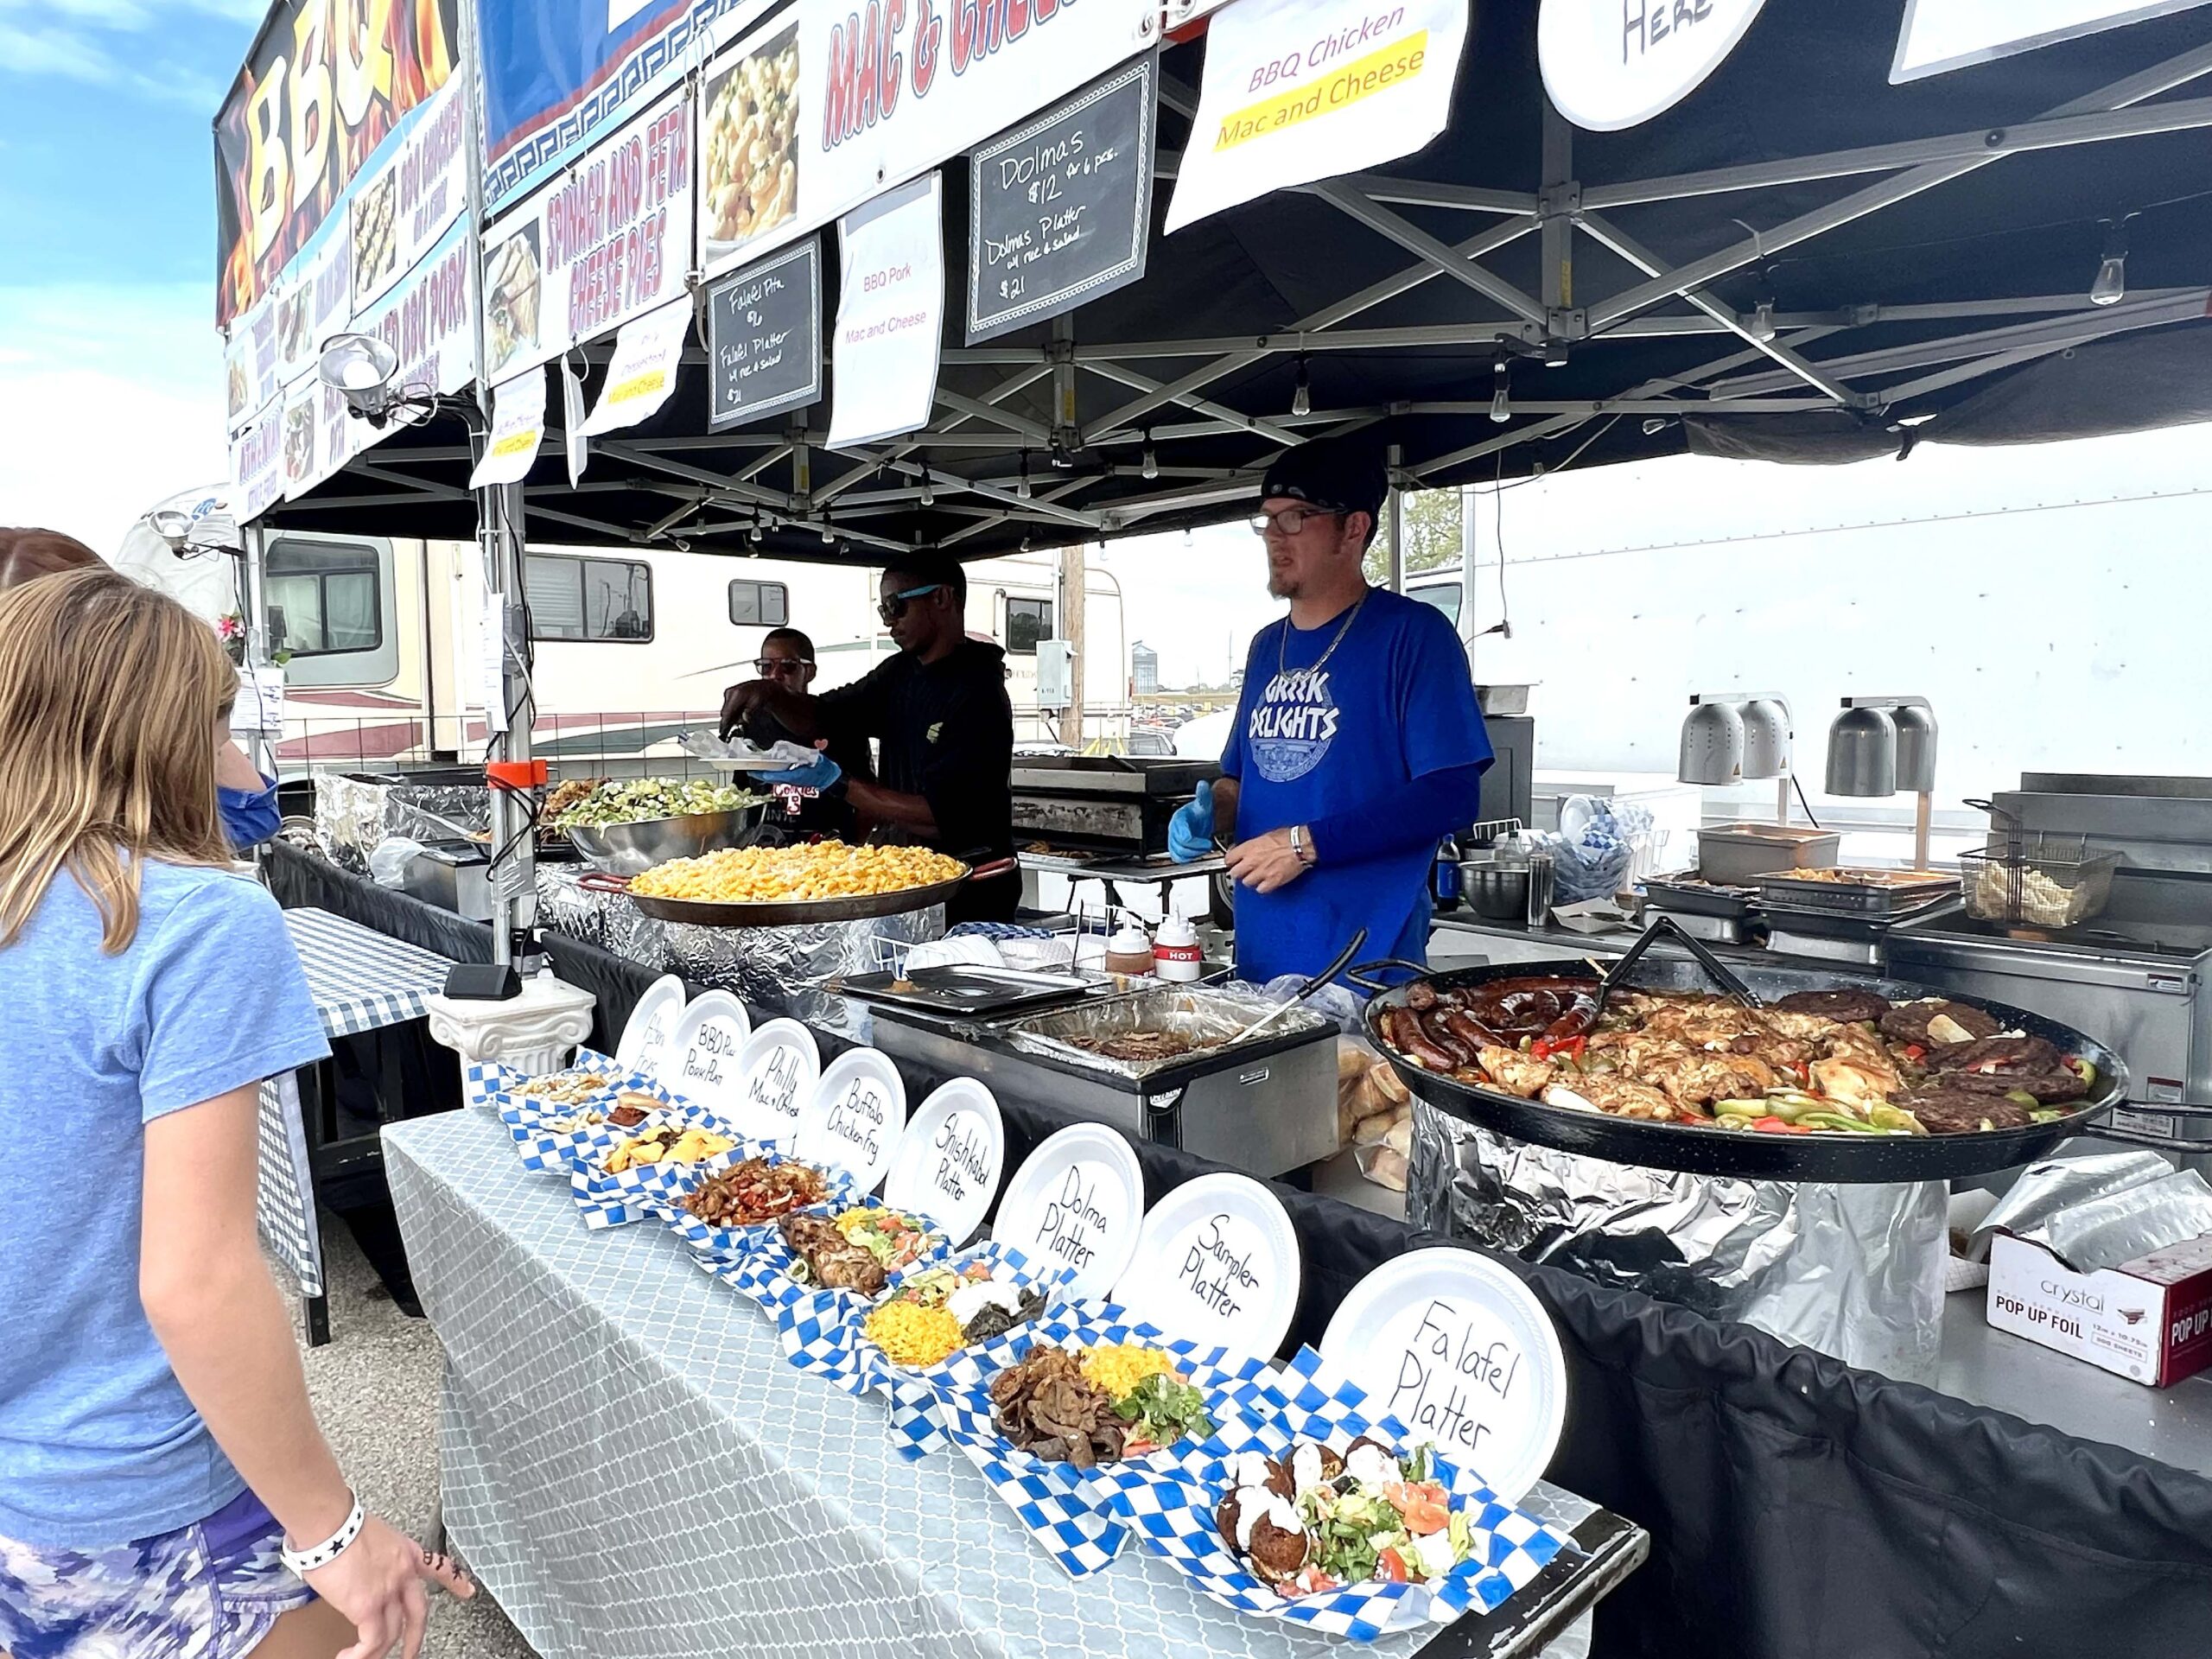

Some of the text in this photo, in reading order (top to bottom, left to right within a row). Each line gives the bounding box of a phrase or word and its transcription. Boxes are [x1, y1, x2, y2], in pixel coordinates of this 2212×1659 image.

[1248, 6, 1405, 93] BBQ Chicken
[1623, 0, 1713, 66] HERE
[823, 0, 906, 152] MAC
[1215, 50, 1425, 148] Mac and Cheese
[547, 160, 606, 275] SPINACH
[607, 135, 643, 235] AND
[645, 100, 688, 210] FETA
[999, 130, 1084, 191] Dolmas
[1027, 174, 1063, 204] $12
[984, 205, 1087, 266] Dolmas Platter
[430, 237, 467, 346] PORK
[568, 207, 666, 340] CHEESE PIES
[863, 262, 912, 292] BBQ Pork
[999, 276, 1026, 300] $21
[753, 327, 794, 354] Platter
[846, 311, 927, 345] Mac and Cheese
[1265, 671, 1330, 703] GREEK
[1249, 705, 1340, 741] DELIGHTS
[1169, 951, 1192, 961] HOT
[765, 1046, 799, 1105] Philly
[846, 1077, 884, 1126] Buffalo
[827, 1104, 880, 1166] Chicken Fry
[935, 1157, 966, 1201] Platter
[1060, 1165, 1107, 1234] Dolma
[1036, 1202, 1096, 1269] Platter
[1198, 1214, 1259, 1288] Sampler
[1179, 1245, 1241, 1318] Platter
[2040, 1280, 2105, 1312] crystal
[1996, 1295, 2024, 1315] POP
[2027, 1306, 2048, 1324] UP
[2051, 1314, 2083, 1339] FOIL
[2171, 1309, 2209, 1347] POP UP
[1414, 1300, 1521, 1400] Falafel
[1388, 1349, 1491, 1451] Platter
